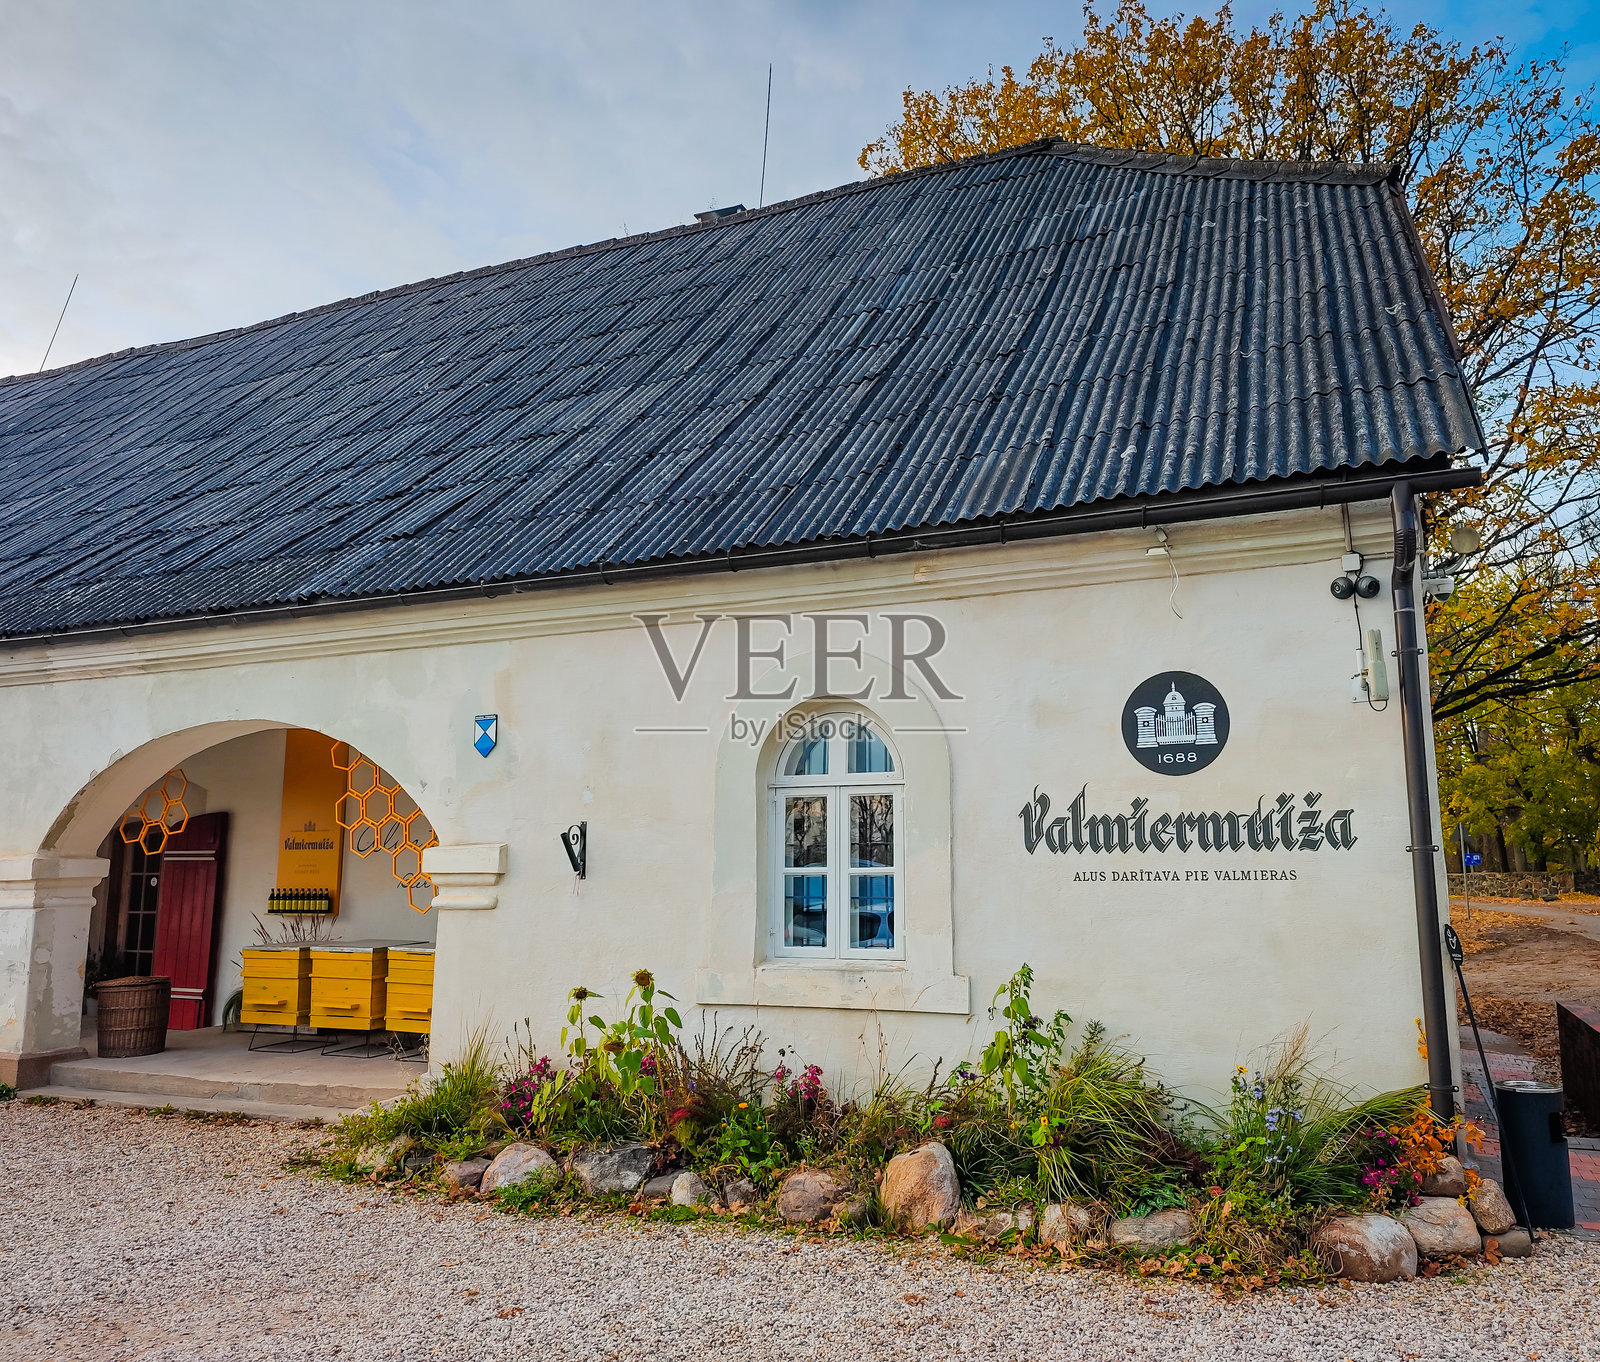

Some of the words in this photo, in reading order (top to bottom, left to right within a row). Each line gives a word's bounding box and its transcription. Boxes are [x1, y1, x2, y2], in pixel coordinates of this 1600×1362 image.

[1157, 752, 1198, 764] 1688
[1018, 782, 1358, 855] Valmiermuiža
[1073, 871, 1107, 882] ALUS
[1111, 869, 1181, 882] DARĪTAVA
[1184, 870, 1209, 881] PIE
[1214, 869, 1298, 881] VALMIERAS
